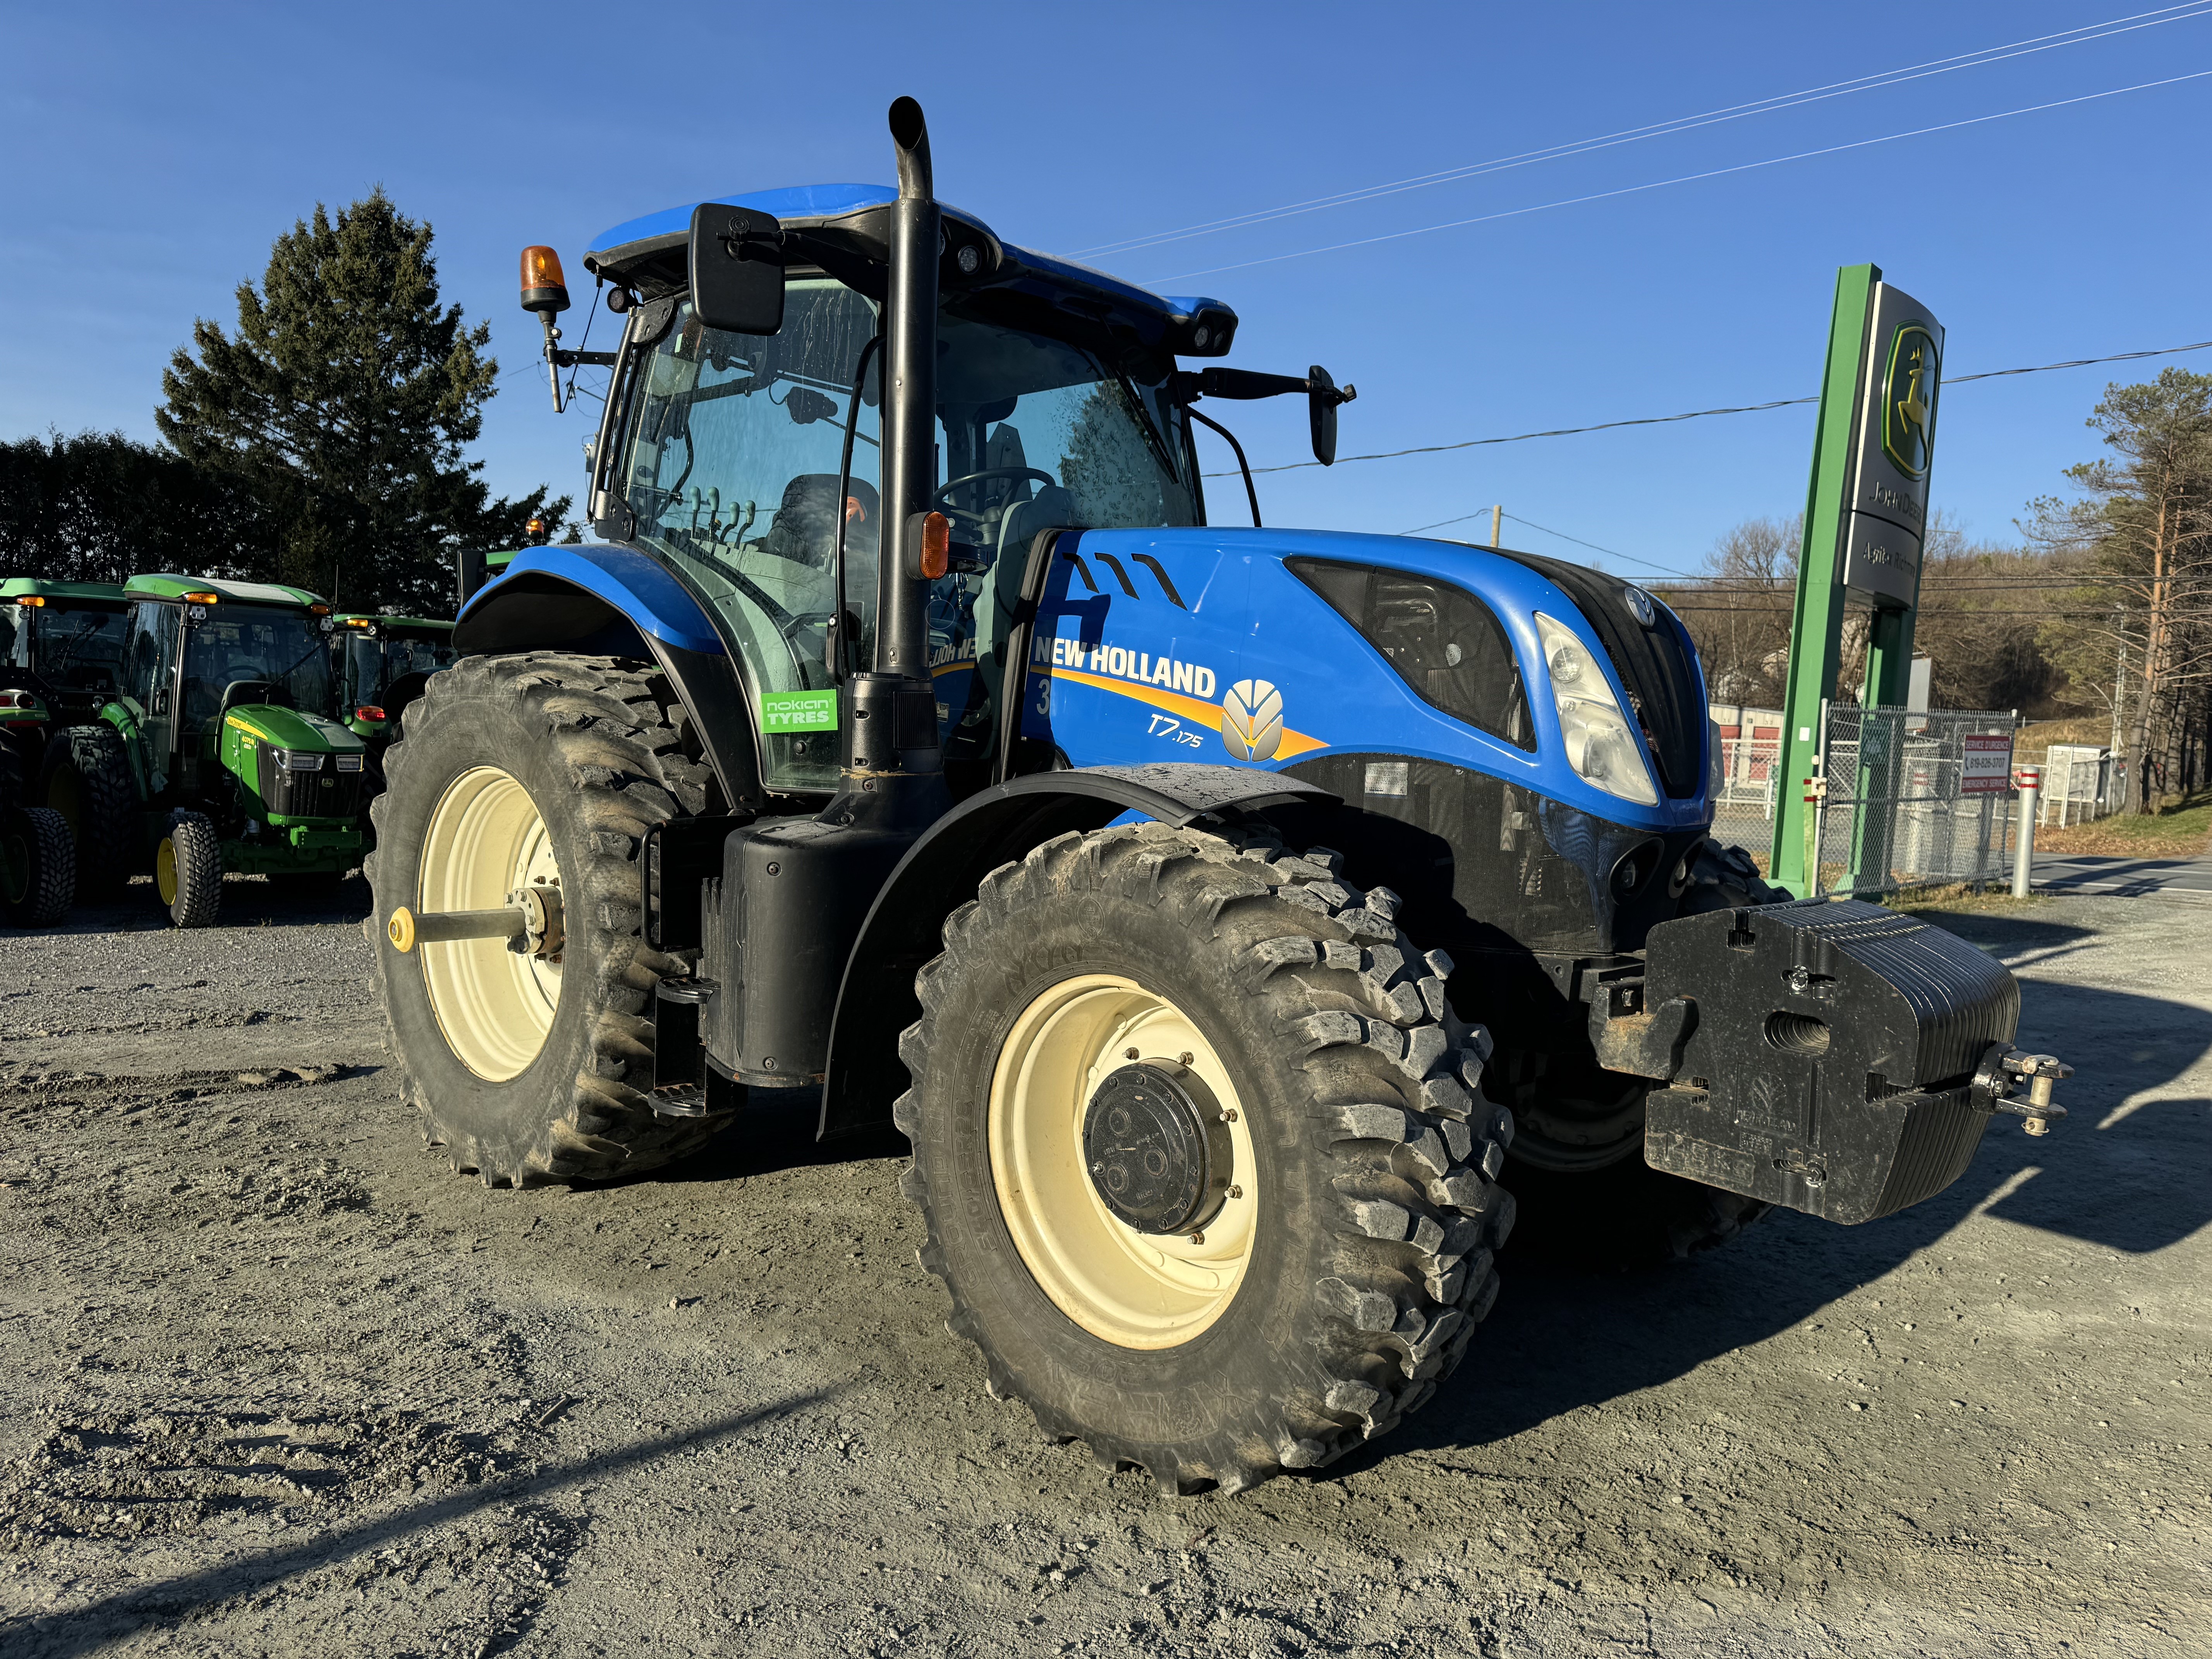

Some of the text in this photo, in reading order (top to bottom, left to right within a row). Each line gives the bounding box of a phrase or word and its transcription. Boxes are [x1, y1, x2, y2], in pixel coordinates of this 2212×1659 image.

[1869, 481, 1902, 511] JOHN
[1034, 636, 1216, 699] NEW HOLLAND
[767, 710, 829, 725] TYRES
[1965, 740, 2009, 750] SERVICE D'URGENCE
[1970, 757, 2005, 769] 819-826-3707
[1963, 778, 2006, 788] EMERGENCY SERVICE
[930, 1152, 981, 1290] GROUND
